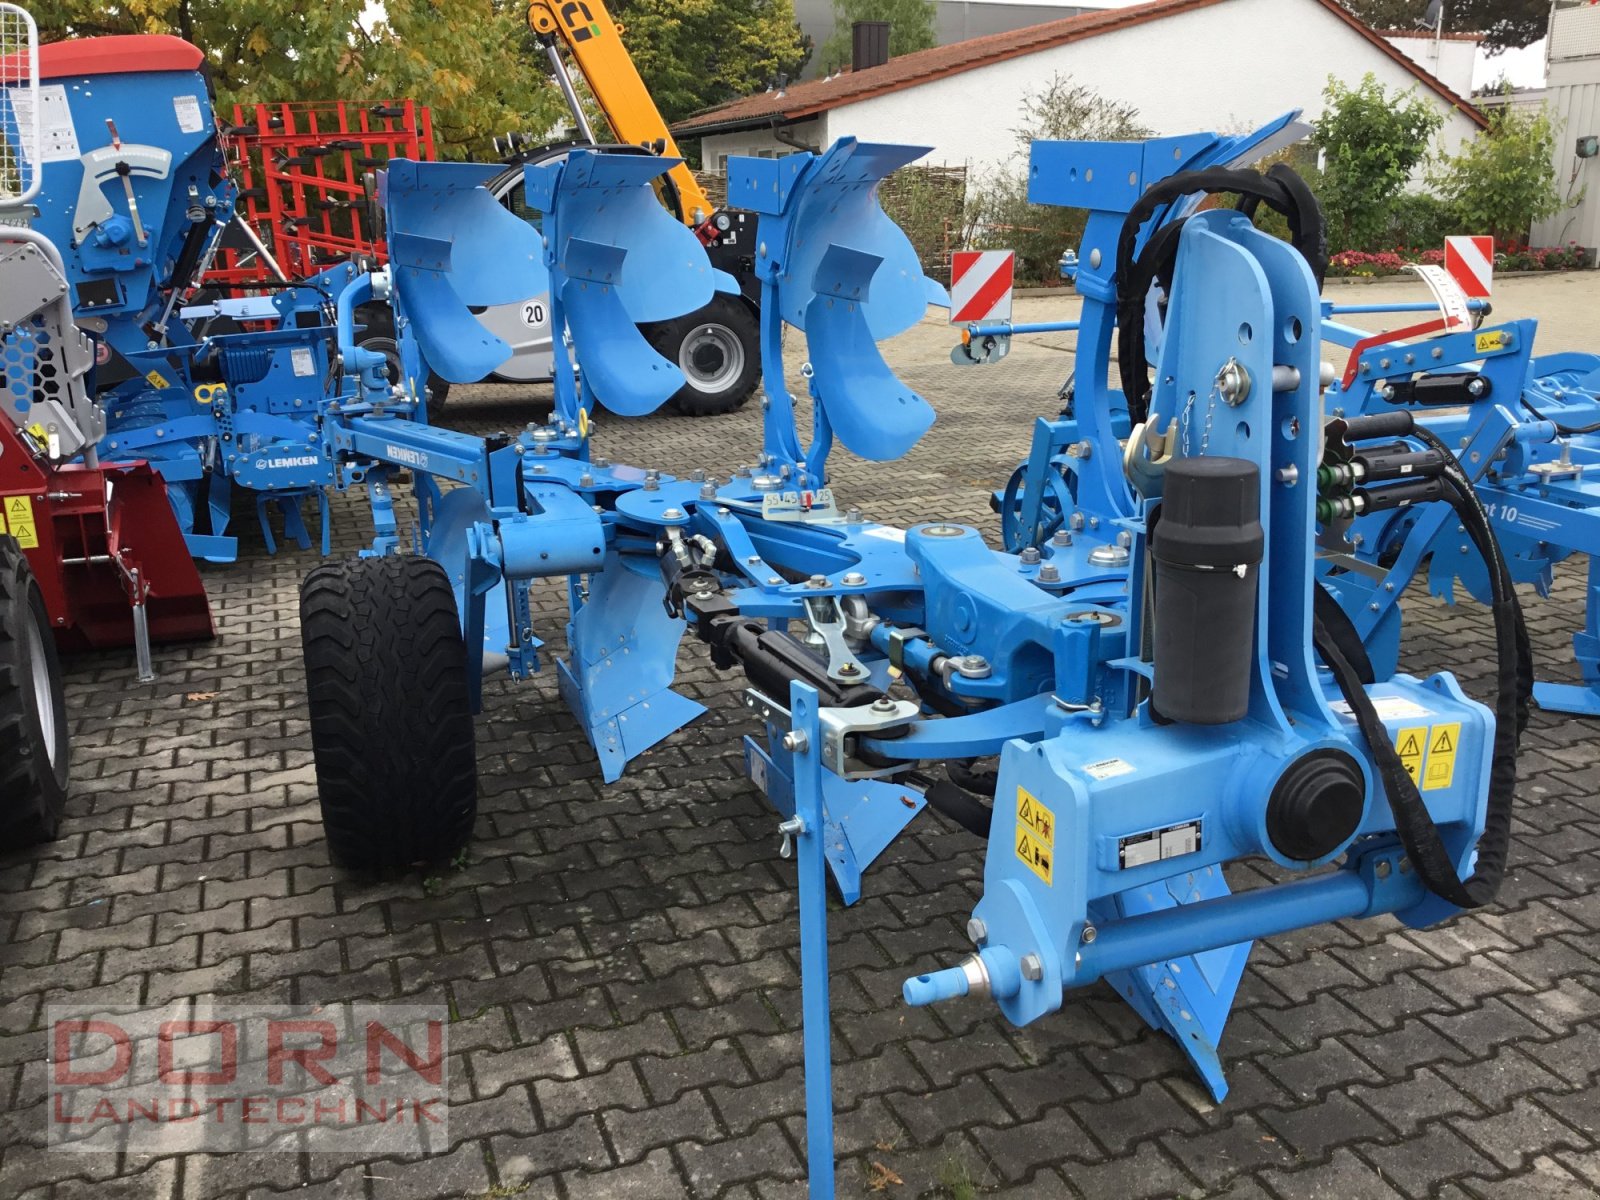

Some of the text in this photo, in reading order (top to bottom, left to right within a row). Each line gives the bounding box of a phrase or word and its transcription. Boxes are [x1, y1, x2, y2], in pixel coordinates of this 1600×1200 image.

[526, 305, 543, 323] 20
[267, 456, 319, 469] LEMKEN
[386, 444, 420, 465] LEMKEN
[766, 494, 779, 506] 55
[784, 492, 798, 504] 45
[819, 490, 831, 502] 25
[1500, 505, 1518, 523] 10
